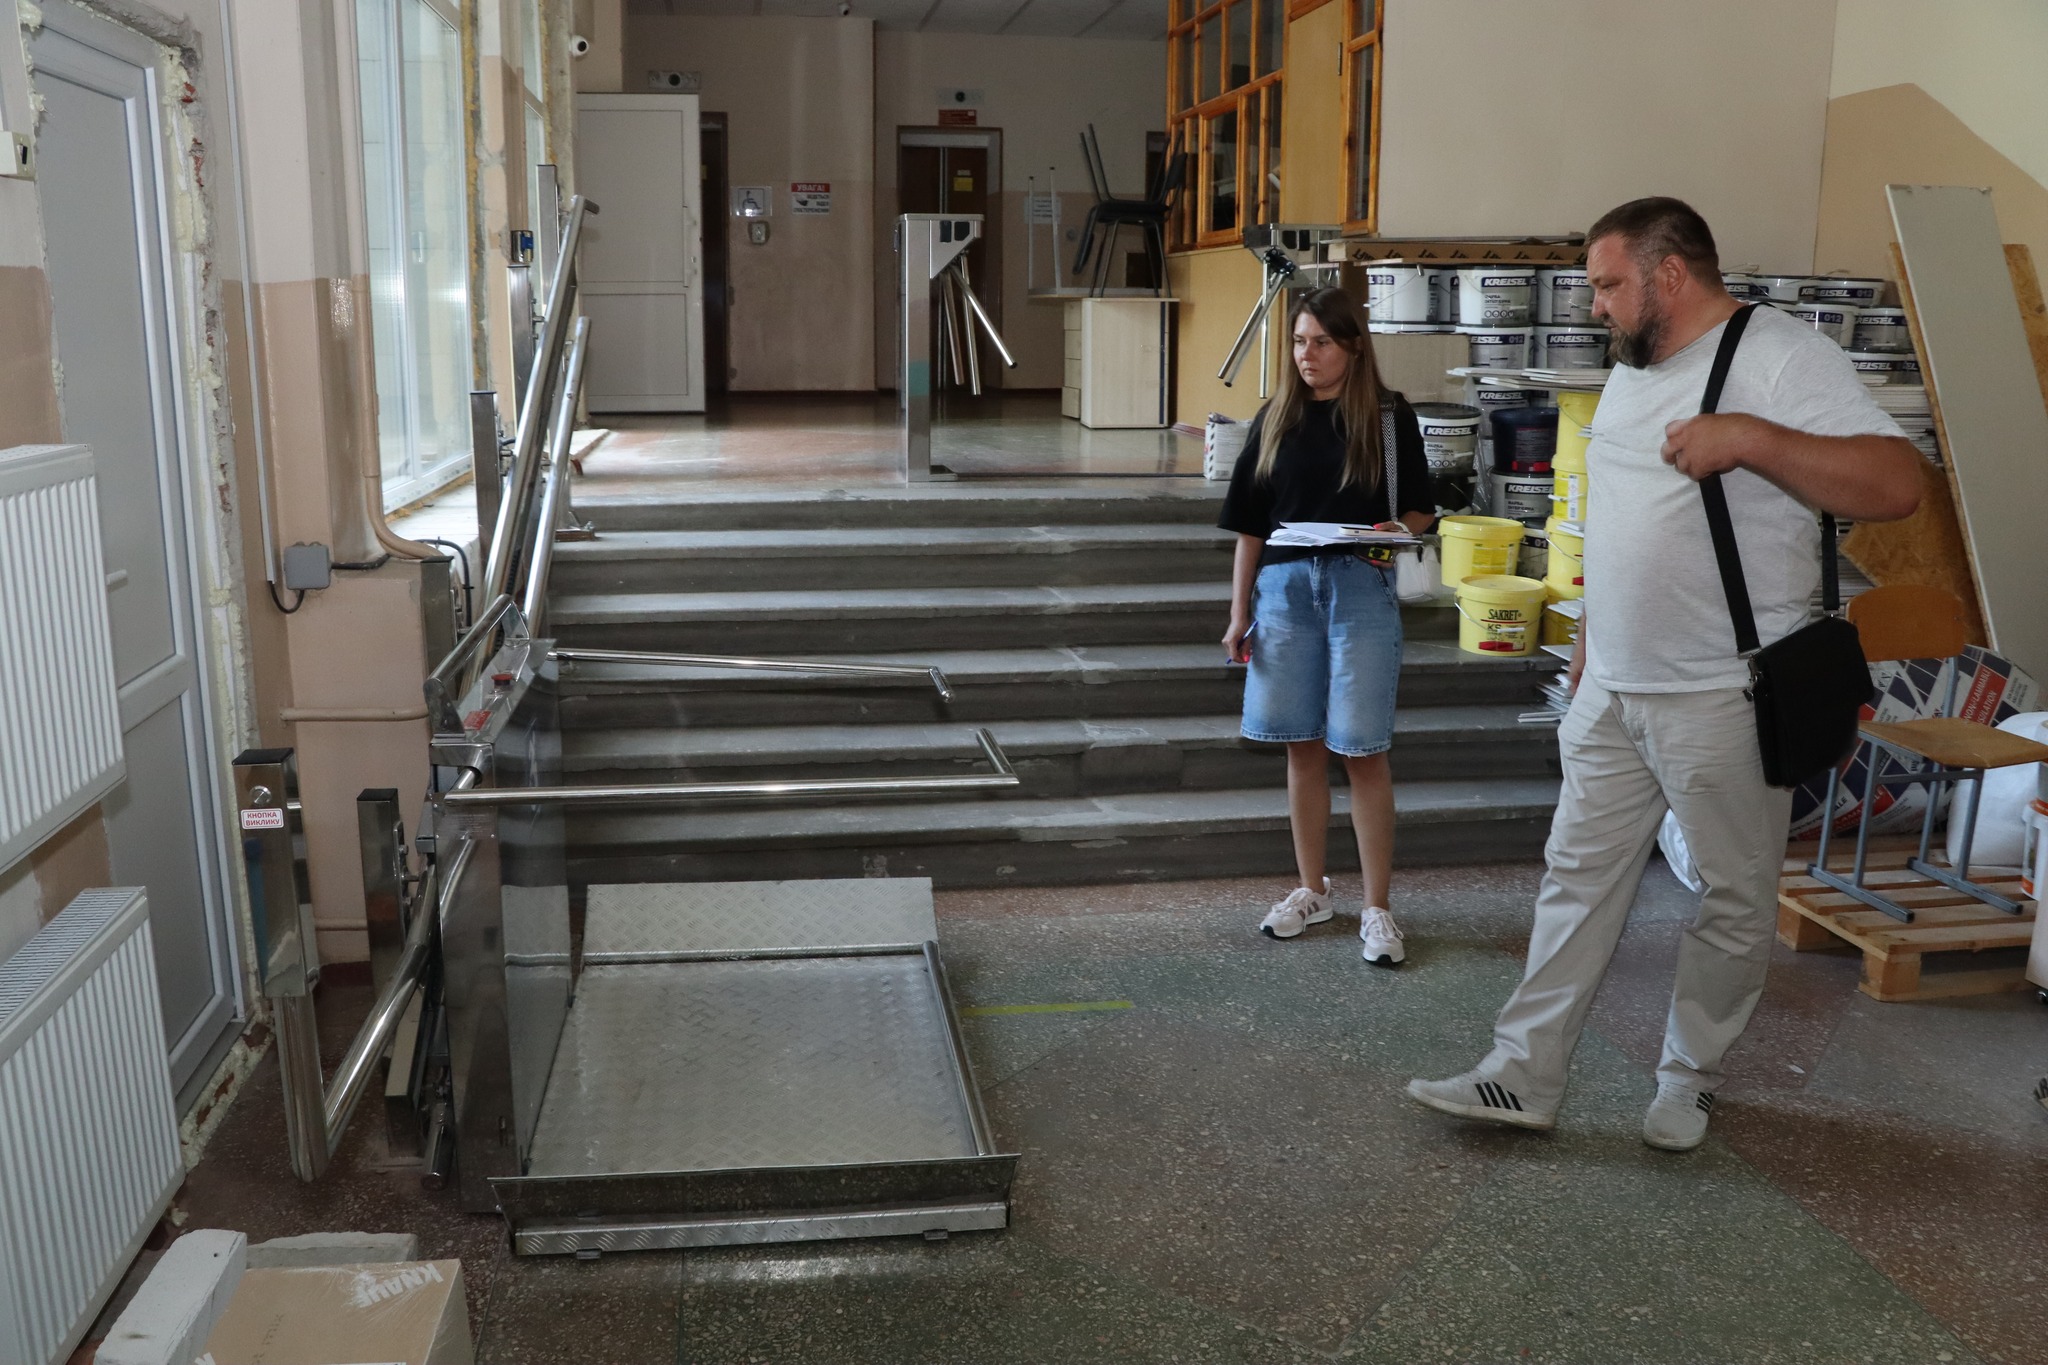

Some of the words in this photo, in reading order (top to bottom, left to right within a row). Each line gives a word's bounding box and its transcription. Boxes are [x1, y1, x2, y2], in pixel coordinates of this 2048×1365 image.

[1484, 278, 1527, 286] KREISEL
[1824, 313, 1842, 322] 012
[1857, 317, 1896, 325] REISEL
[1471, 336, 1503, 344] EISEL
[1509, 336, 1523, 344] 012
[1550, 335, 1595, 343] KREISEL
[1853, 362, 1892, 370] REISEL
[1479, 392, 1523, 400] KREISEL
[1427, 427, 1472, 436] KREISEL
[1534, 539, 1547, 548] 01
[1488, 609, 1519, 620] SAKRET
[1978, 691, 1998, 725] SULATION
